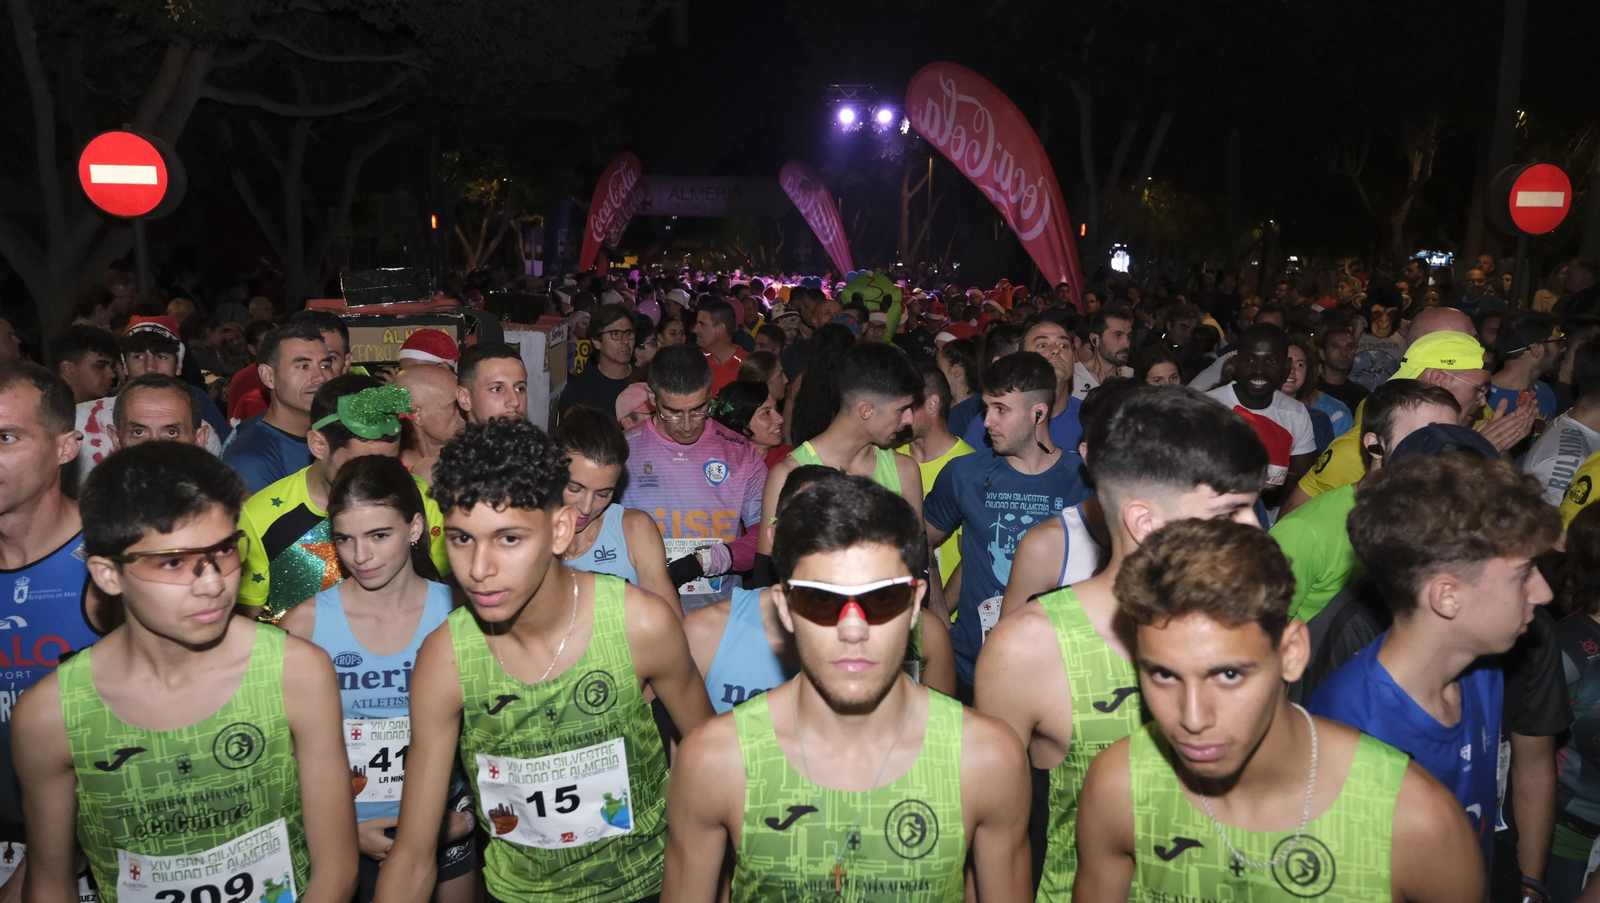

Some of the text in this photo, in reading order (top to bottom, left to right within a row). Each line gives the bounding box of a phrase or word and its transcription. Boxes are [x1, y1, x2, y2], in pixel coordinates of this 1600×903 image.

[590, 160, 638, 242] Coca-Cola
[1548, 428, 1583, 490] BULKING
[985, 501, 1008, 509] CIUDAD
[1009, 502, 1019, 510] DE
[986, 492, 1049, 503] XIV SAN SILVESTRE
[371, 720, 408, 731] XIV SAN
[371, 730, 405, 741] CIUDAD
[507, 744, 616, 773] XIV SAN SILVESTRE
[508, 771, 549, 784] CIUDAD
[552, 768, 567, 780] DE
[526, 784, 581, 818] 15
[150, 859, 171, 872] XIV
[176, 856, 204, 869] SAN
[207, 825, 278, 862] SILVESTRE
[152, 868, 202, 883] CIUDAD
[206, 863, 223, 876] DE
